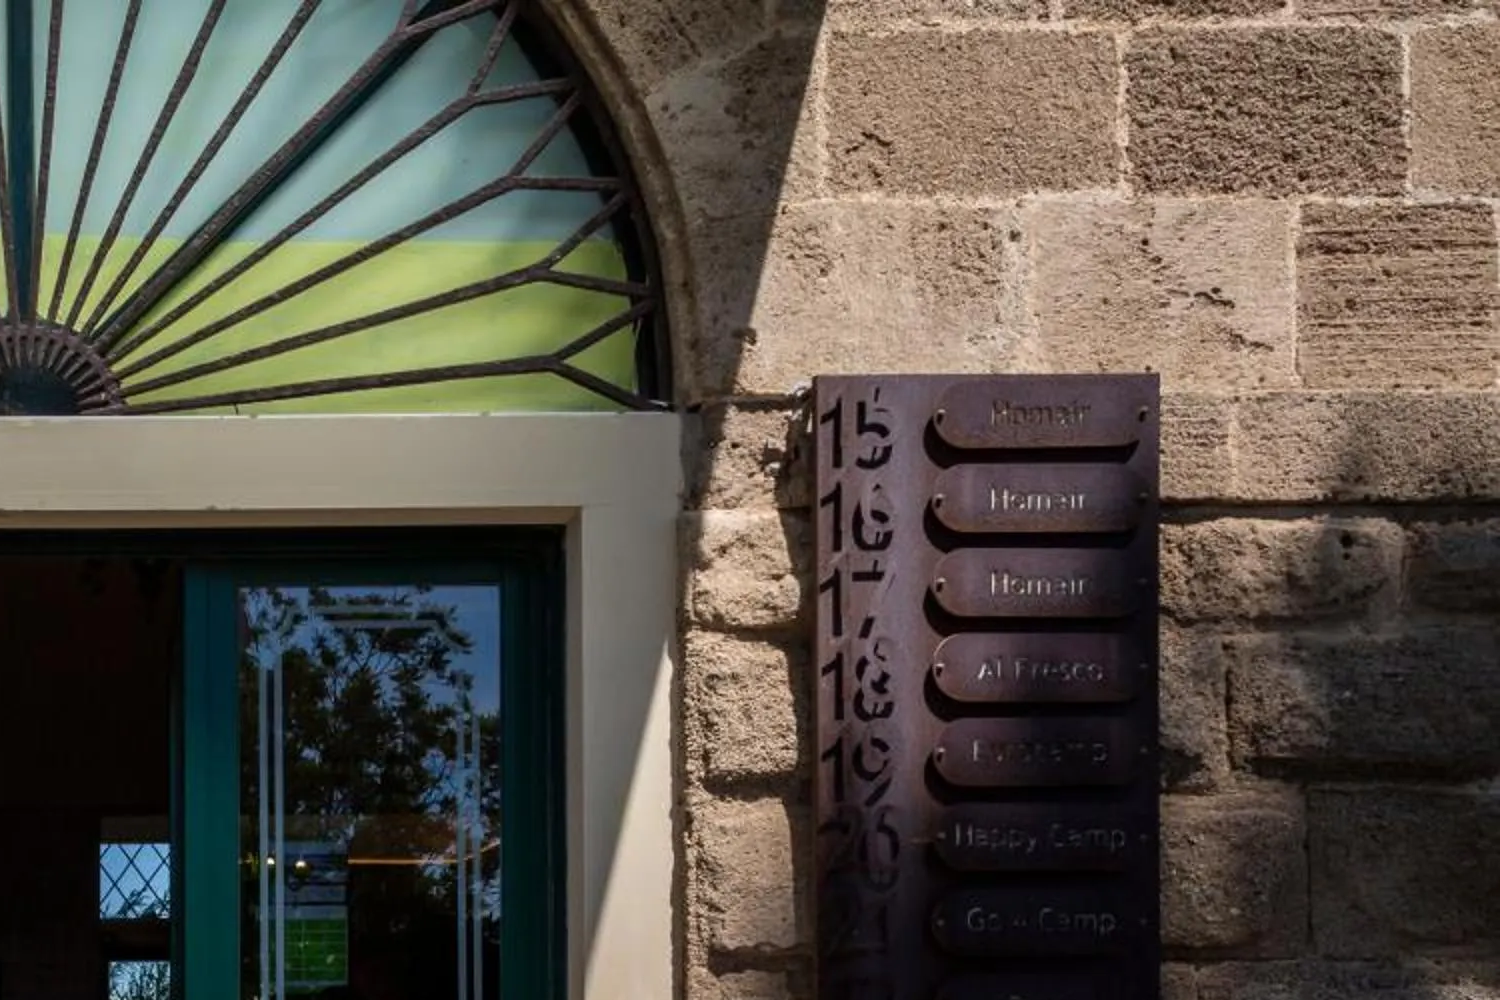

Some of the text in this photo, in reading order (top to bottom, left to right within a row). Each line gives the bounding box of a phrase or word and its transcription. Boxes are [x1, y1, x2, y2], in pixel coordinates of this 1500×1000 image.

[819, 394, 1092, 471] 15 Homair
[819, 482, 1087, 552] 16 Homair
[819, 563, 1088, 638] 17 Homair
[820, 650, 1104, 722] 18 Al Fresco
[820, 736, 894, 806] 19
[954, 822, 1037, 855] Happy
[1049, 822, 1127, 853] Camp
[1038, 905, 1118, 938] Camp
